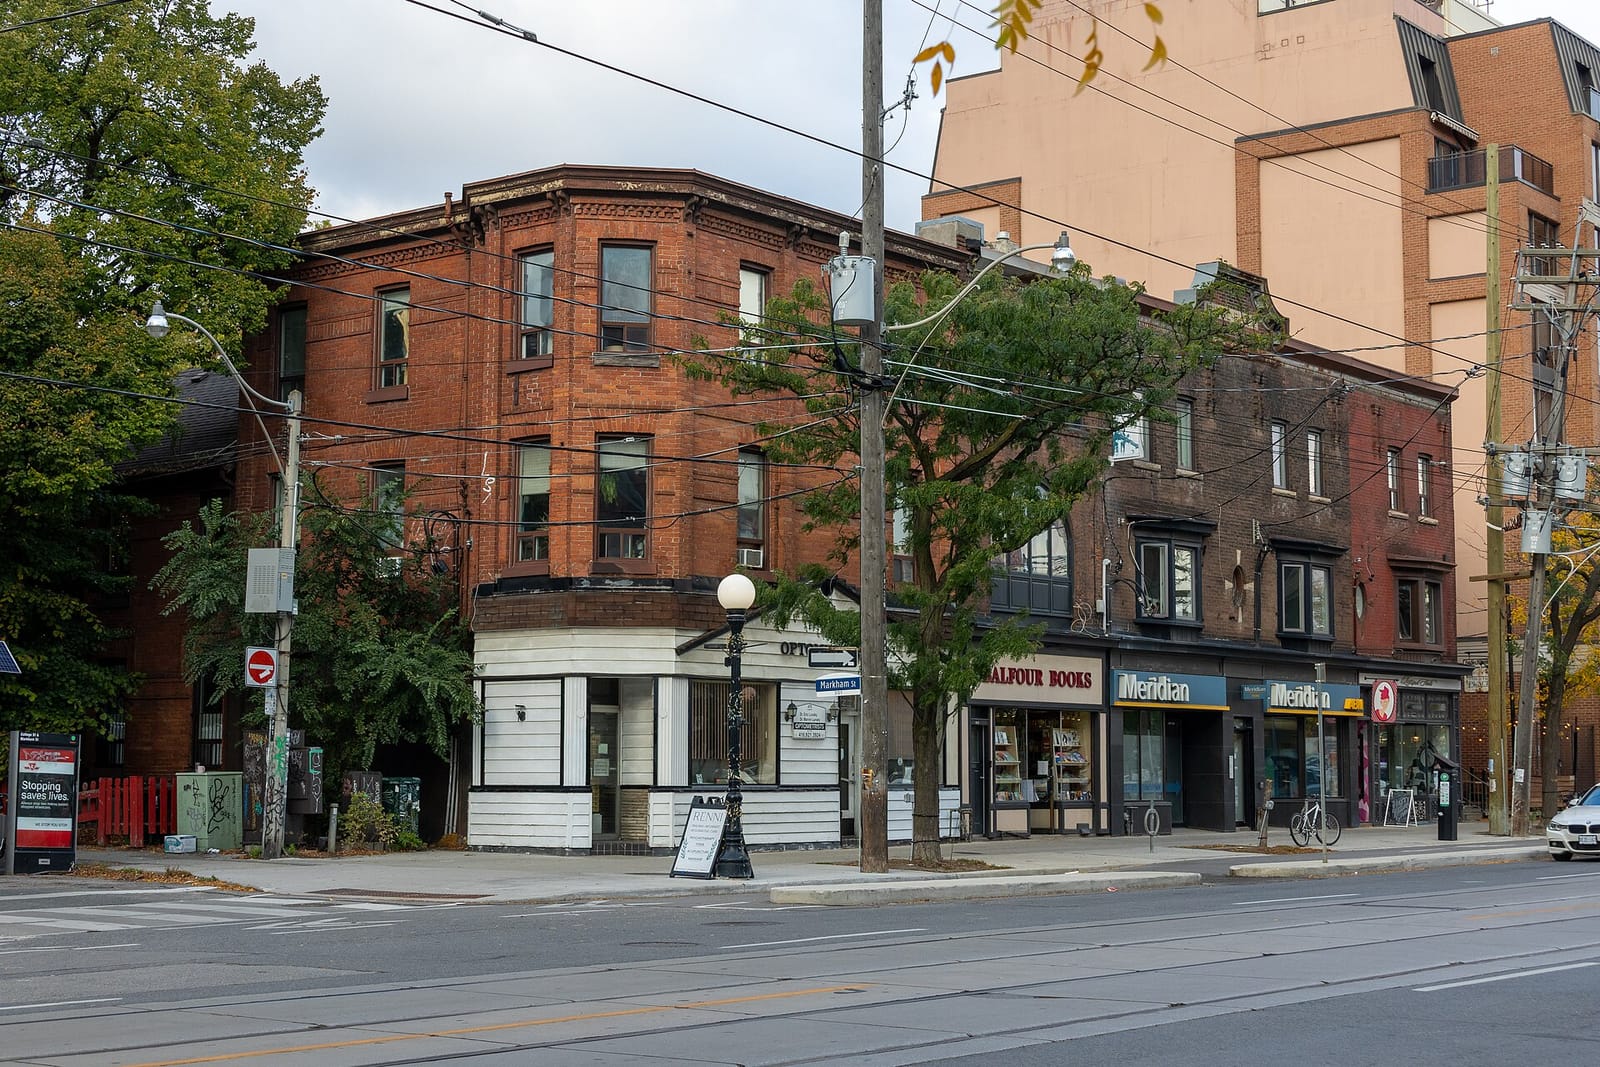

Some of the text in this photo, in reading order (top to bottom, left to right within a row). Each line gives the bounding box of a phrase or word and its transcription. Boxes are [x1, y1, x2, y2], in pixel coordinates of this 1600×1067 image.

[820, 681, 850, 689] Markham
[1049, 670, 1092, 688] BOOKS
[1118, 673, 1190, 702] Meridian
[22, 780, 61, 793] Stopping
[21, 791, 70, 801] saves lives.
